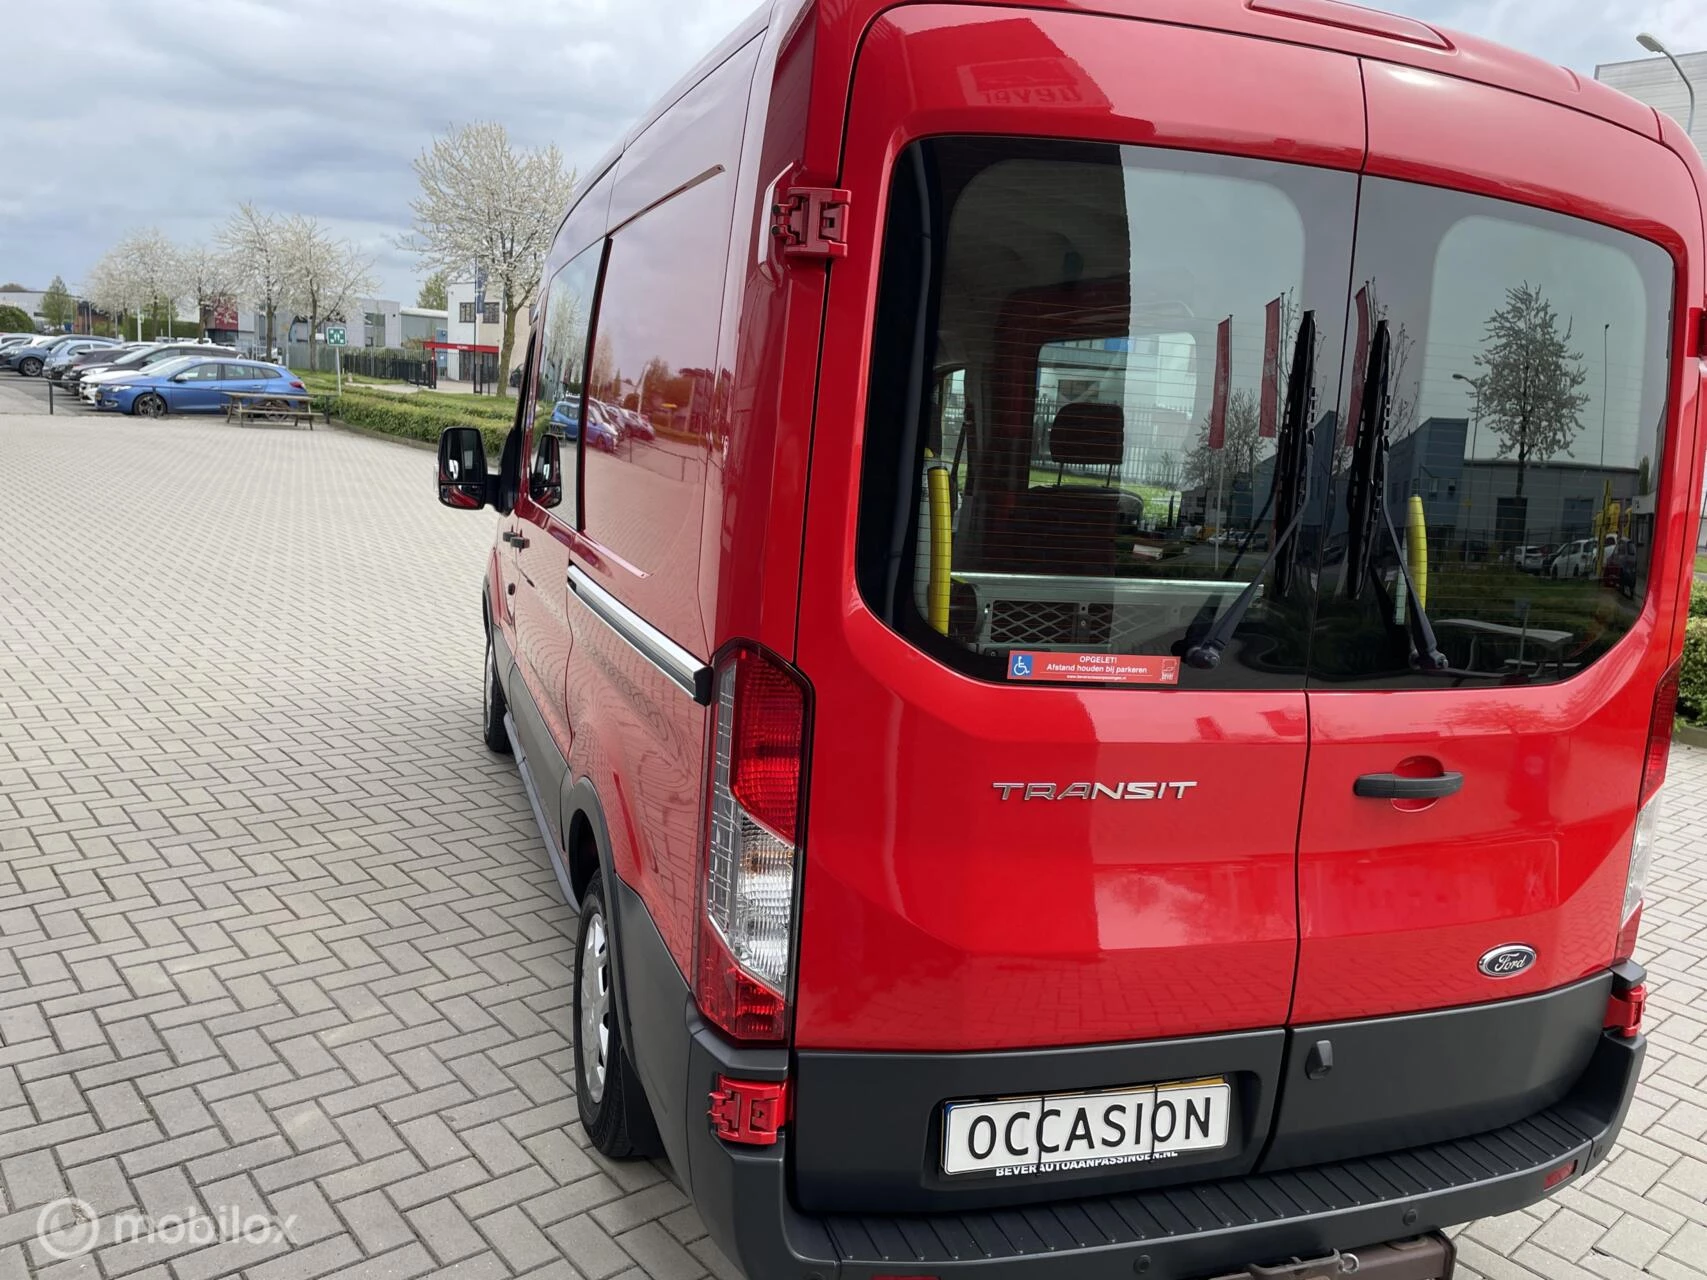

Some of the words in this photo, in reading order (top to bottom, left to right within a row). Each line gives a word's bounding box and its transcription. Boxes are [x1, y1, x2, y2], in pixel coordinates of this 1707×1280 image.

[1080, 655, 1117, 664] OPGELET!
[1106, 666, 1114, 674] bij
[1116, 666, 1147, 674] parkeren
[993, 781, 1198, 801] TRANSIT
[1494, 952, 1527, 971] Ford
[967, 1096, 1212, 1160] OCCASION
